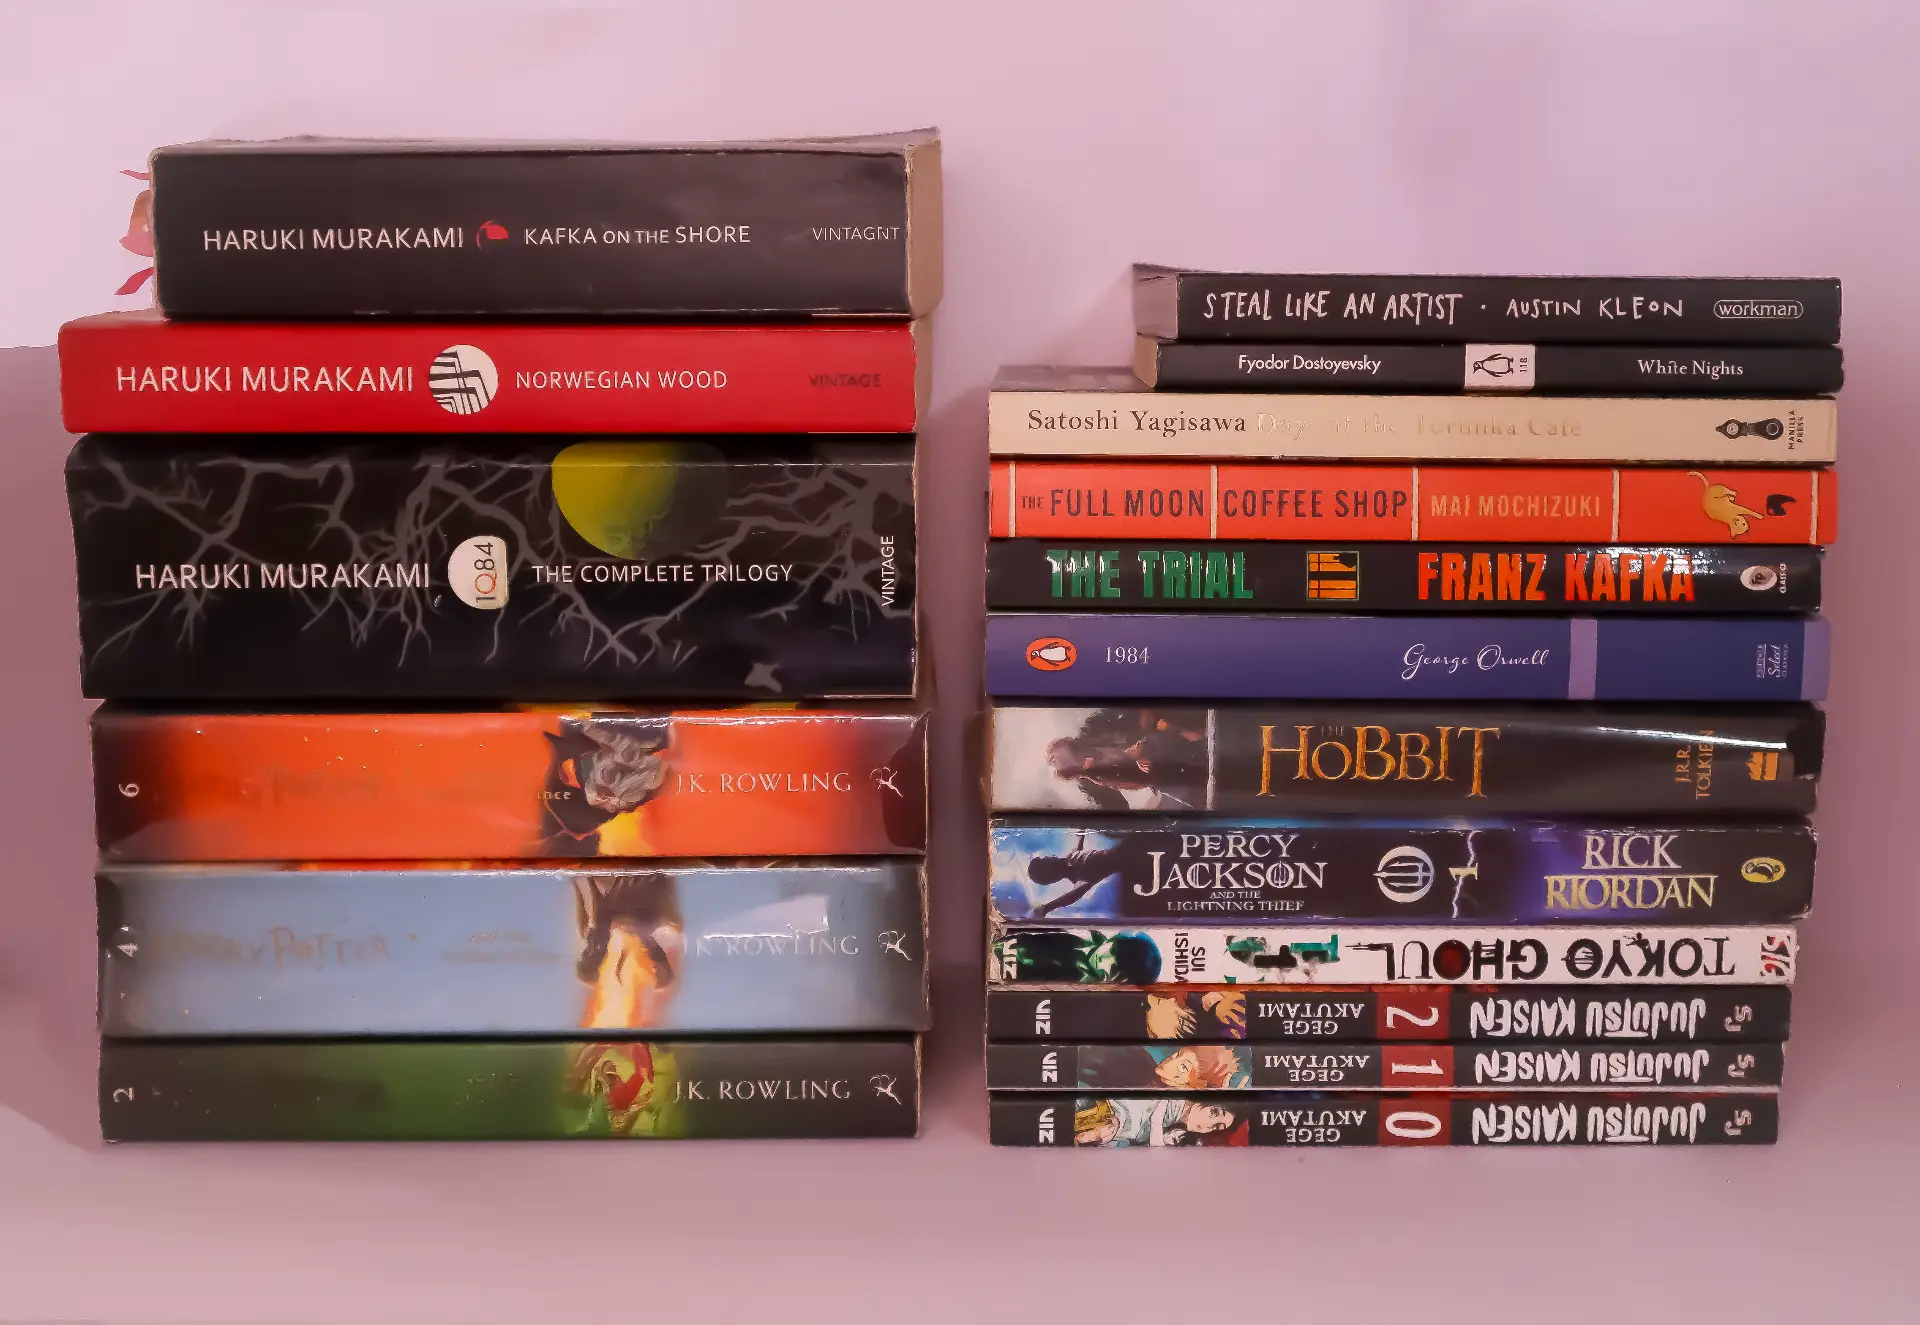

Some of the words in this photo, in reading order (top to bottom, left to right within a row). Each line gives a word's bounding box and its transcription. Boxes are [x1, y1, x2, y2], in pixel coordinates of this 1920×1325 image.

[202, 227, 306, 253] HARUKI
[312, 226, 465, 252] MURAKAMI
[523, 226, 598, 247] KAFKA
[602, 229, 632, 245] ON
[634, 229, 670, 245] THE
[674, 225, 751, 245] SHORE
[1203, 289, 1272, 321] STEAL
[1285, 290, 1331, 320] LIKE
[1343, 292, 1376, 320] AN
[1383, 291, 1463, 326] ARTIST
[1505, 297, 1582, 319] AUSTIN
[1599, 295, 1684, 320] KLEON
[1718, 301, 1799, 317] workman
[1238, 354, 1290, 374] Fyodor
[1292, 354, 1382, 375] Dostoyevsky
[1519, 357, 1528, 373] 118
[1637, 358, 1690, 375] White
[1692, 359, 1744, 378] Nights
[115, 364, 233, 394] HARUKI
[240, 364, 415, 394] MURAKAMI
[515, 369, 651, 391] NORWEGIAN
[657, 369, 729, 391] WOOD
[808, 373, 883, 388] VINTAGE
[1027, 409, 1118, 431] Satoshi
[1129, 409, 1246, 437] Yagisawa
[1787, 409, 1796, 450] MANILLA
[1021, 494, 1045, 509] THE
[1050, 488, 1115, 517] FULL
[1124, 488, 1205, 517] MOON
[1222, 489, 1323, 518] COFFEE
[1334, 489, 1408, 518] SHOP
[1430, 494, 1471, 517] MAI
[1477, 494, 1601, 518] MOCHIZUKI
[134, 561, 252, 590] HARUKI
[259, 561, 431, 590] MURAKAMI
[531, 563, 574, 584] THE
[578, 563, 695, 584] COMPLETE
[700, 563, 795, 584] TRILOGY
[881, 534, 896, 607] VINTAGE
[1046, 549, 1121, 599] THE
[1137, 550, 1254, 599] TRIAL
[1417, 552, 1548, 601] FRANZ
[1564, 552, 1696, 602] KAFKA
[1104, 646, 1150, 664] 1984
[1400, 643, 1469, 681] George
[1476, 643, 1551, 671] Orwell
[1256, 724, 1501, 798] HOBBIT
[118, 783, 139, 798] 6
[674, 773, 712, 796] J.K.
[720, 771, 852, 794] ROWLING
[1179, 833, 1300, 859] PERCY
[1581, 834, 1683, 869] RICK
[1133, 850, 1329, 897] JACKSON
[1209, 890, 1235, 899] AND
[1239, 890, 1262, 899] THE
[1543, 874, 1719, 910] RIORDAN
[1167, 900, 1255, 912] LIGHTNING
[1257, 900, 1305, 912] THIEF
[723, 934, 859, 956] ROWLING
[1174, 932, 1189, 982] ISHIDA
[1561, 932, 1736, 979] TOKYO
[1002, 938, 1018, 980] VIZ
[1191, 946, 1206, 972] SUI
[1344, 938, 1549, 981] GHOUL
[1035, 999, 1051, 1035] VIZ
[1258, 1002, 1365, 1019] AKUTAMI
[1385, 1005, 1439, 1029] 2
[1469, 996, 1576, 1040] KAISEN
[1585, 997, 1707, 1040] JUJUTSU
[1282, 1020, 1339, 1036] GEGE
[1041, 1051, 1058, 1083] VIZ
[1264, 1054, 1370, 1069] AKUTAMI
[1391, 1059, 1444, 1077] 1
[1474, 1048, 1581, 1084] KAISEN
[1590, 1049, 1710, 1085] JUJUTSU
[1288, 1069, 1345, 1082] GEGE
[673, 1079, 711, 1104] J.K.
[719, 1079, 851, 1101] ROWLING
[1038, 1108, 1054, 1144] VIZ
[1261, 1110, 1367, 1127] AKUTAMI
[1384, 1110, 1442, 1139] 0
[1471, 1101, 1577, 1145] KAISEN
[1586, 1102, 1707, 1145] JUJUTSU
[1286, 1128, 1342, 1143] GEGE
